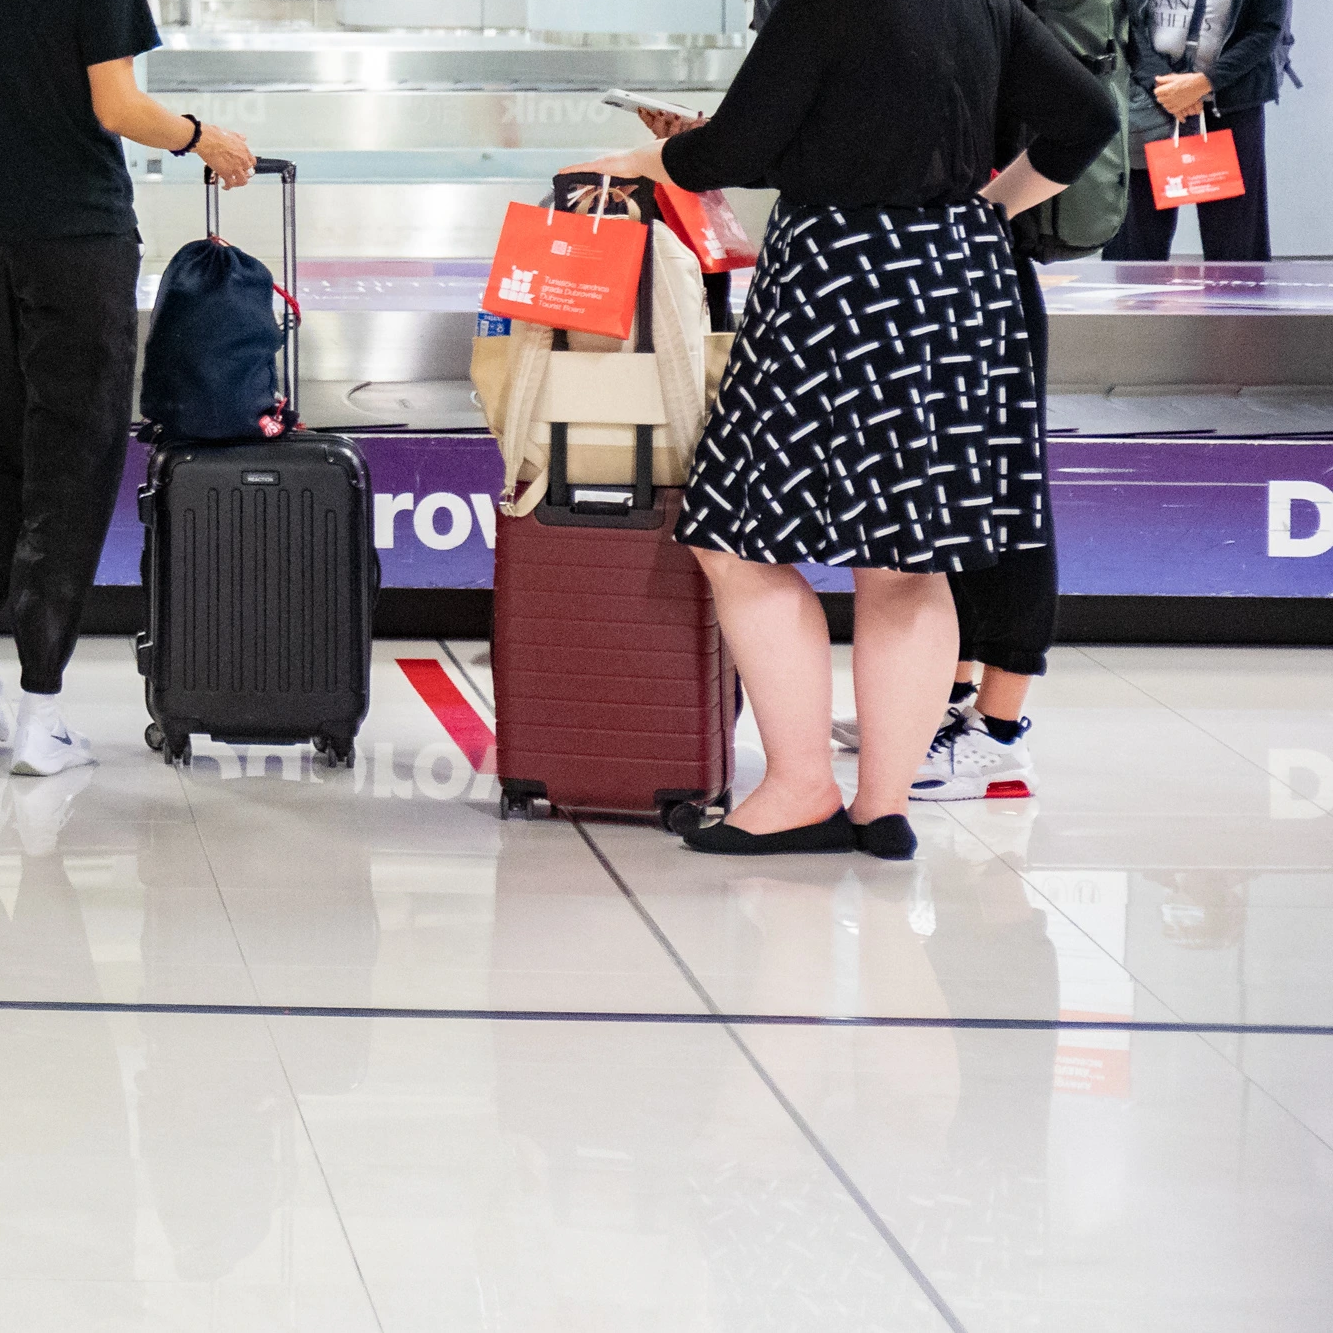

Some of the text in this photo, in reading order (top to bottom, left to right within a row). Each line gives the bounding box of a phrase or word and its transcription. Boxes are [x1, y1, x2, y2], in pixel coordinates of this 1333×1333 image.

[539, 292, 575, 304] Dubrovnik
[538, 300, 586, 314] Tourist Board
[1268, 481, 1333, 558] D
